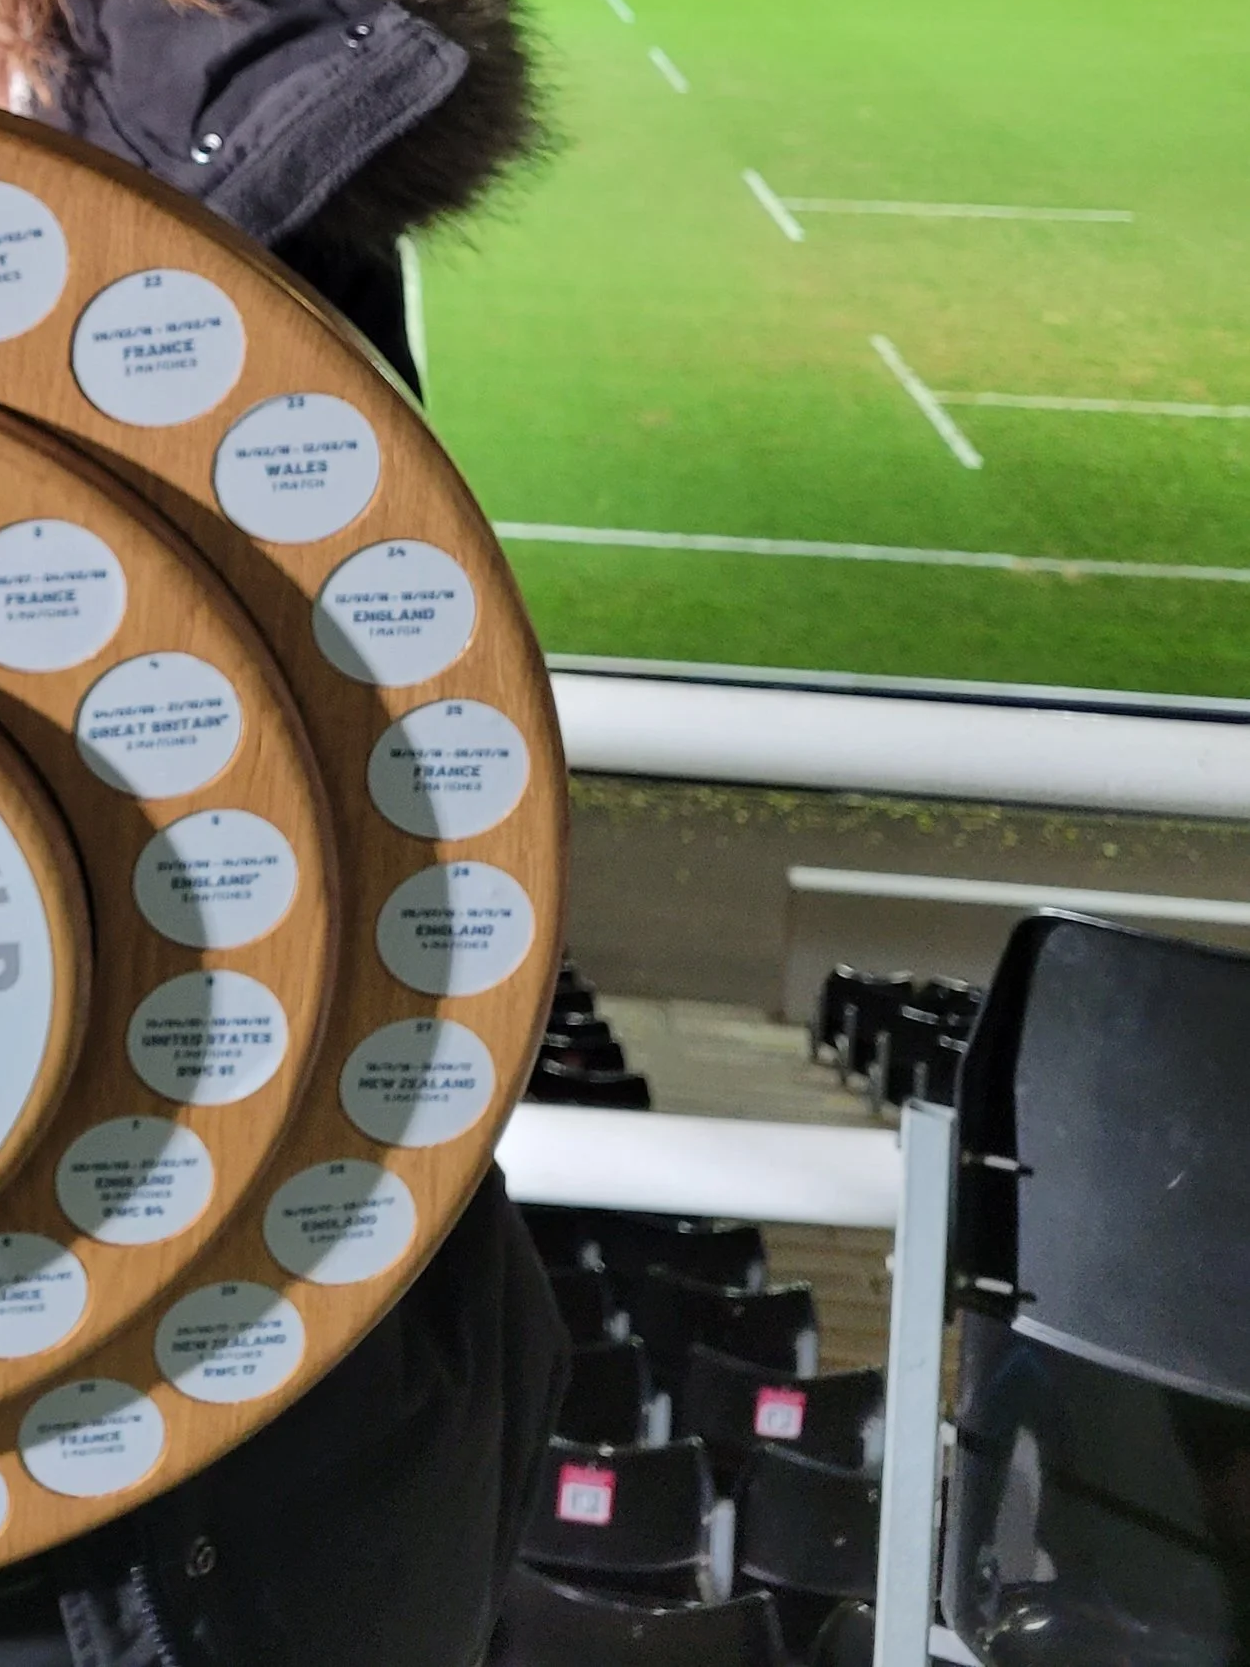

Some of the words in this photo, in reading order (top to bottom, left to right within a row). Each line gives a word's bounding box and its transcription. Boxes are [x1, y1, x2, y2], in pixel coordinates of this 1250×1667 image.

[123, 339, 194, 359] FRANCE
[265, 460, 327, 477] WALES
[5, 590, 75, 605] FRANCE
[353, 607, 435, 623] ENGLAND
[90, 717, 145, 738] GREAT
[412, 765, 483, 778] FRANCE
[414, 924, 494, 938] ENGLAND
[141, 1033, 203, 1047] UNITED
[207, 1033, 273, 1045] STATES
[359, 1077, 394, 1090] NEW
[398, 1077, 476, 1090] ZEALAND
[95, 1175, 174, 1189] ENGLAND
[301, 1214, 378, 1233] ENGLAND
[171, 1339, 208, 1353] NEW
[211, 1334, 288, 1350] ZEALAND
[59, 1431, 121, 1446] FRANCE
